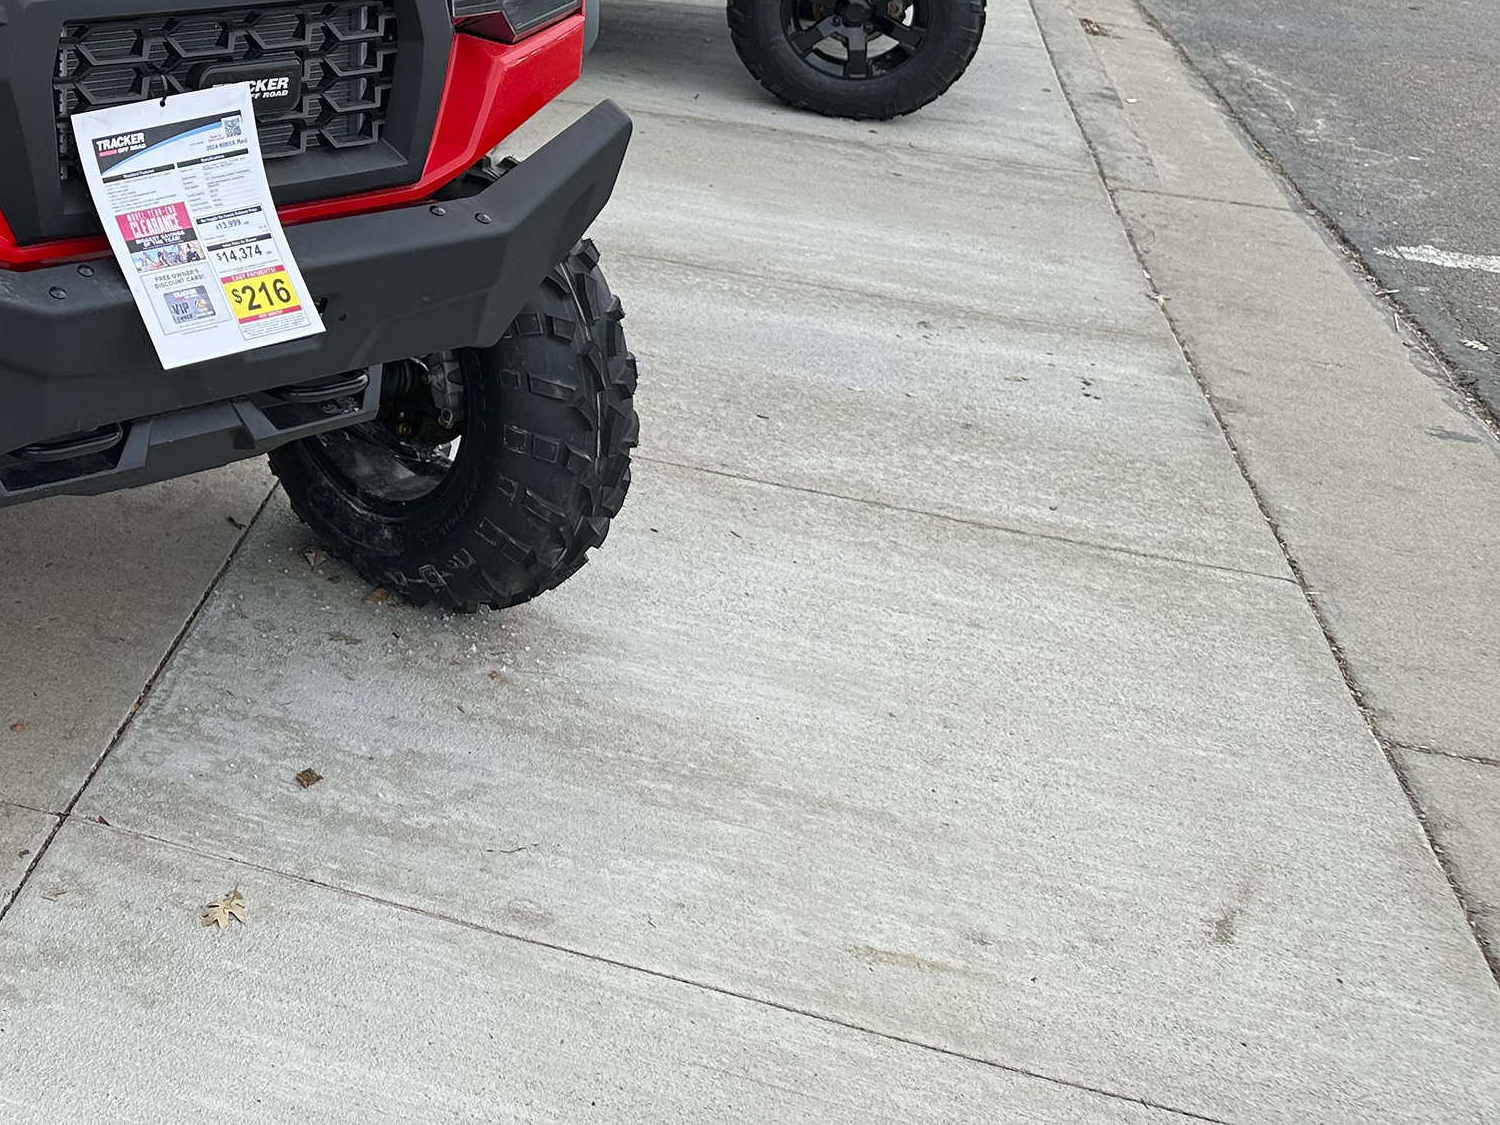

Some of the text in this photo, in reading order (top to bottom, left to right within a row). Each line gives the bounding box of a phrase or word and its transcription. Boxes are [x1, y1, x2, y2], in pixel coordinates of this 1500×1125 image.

[262, 90, 289, 99] ROAD
[96, 132, 145, 152] TRACKER
[117, 146, 129, 154] OFF
[129, 213, 182, 239] CLEARANCE
[215, 218, 241, 230] $13,999
[216, 244, 262, 263] $14,374
[155, 268, 200, 282] FREE OWNER'S
[231, 273, 246, 281] EASY
[246, 267, 277, 278] PAYMENTS!
[154, 274, 205, 290] DISCOUNT CARD!
[231, 278, 291, 311] $216
[171, 301, 189, 316] VIP
